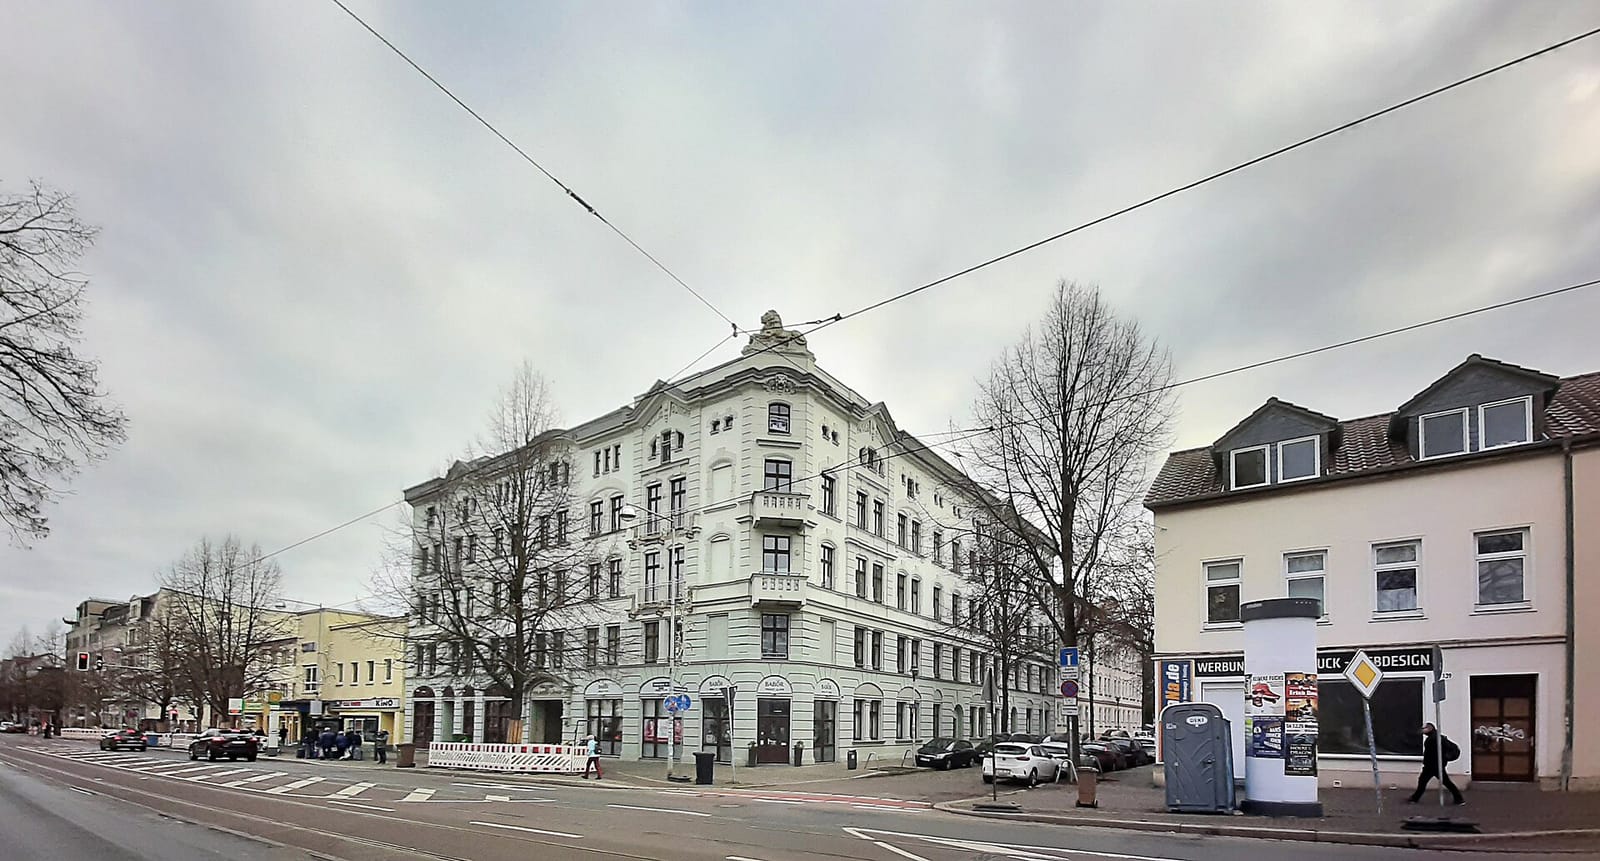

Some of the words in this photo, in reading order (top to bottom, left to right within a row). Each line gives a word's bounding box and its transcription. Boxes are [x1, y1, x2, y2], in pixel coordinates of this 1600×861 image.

[1197, 661, 1244, 673] WERBUN
[1317, 658, 1341, 669] UCK
[1369, 654, 1430, 667] BDESIGN
